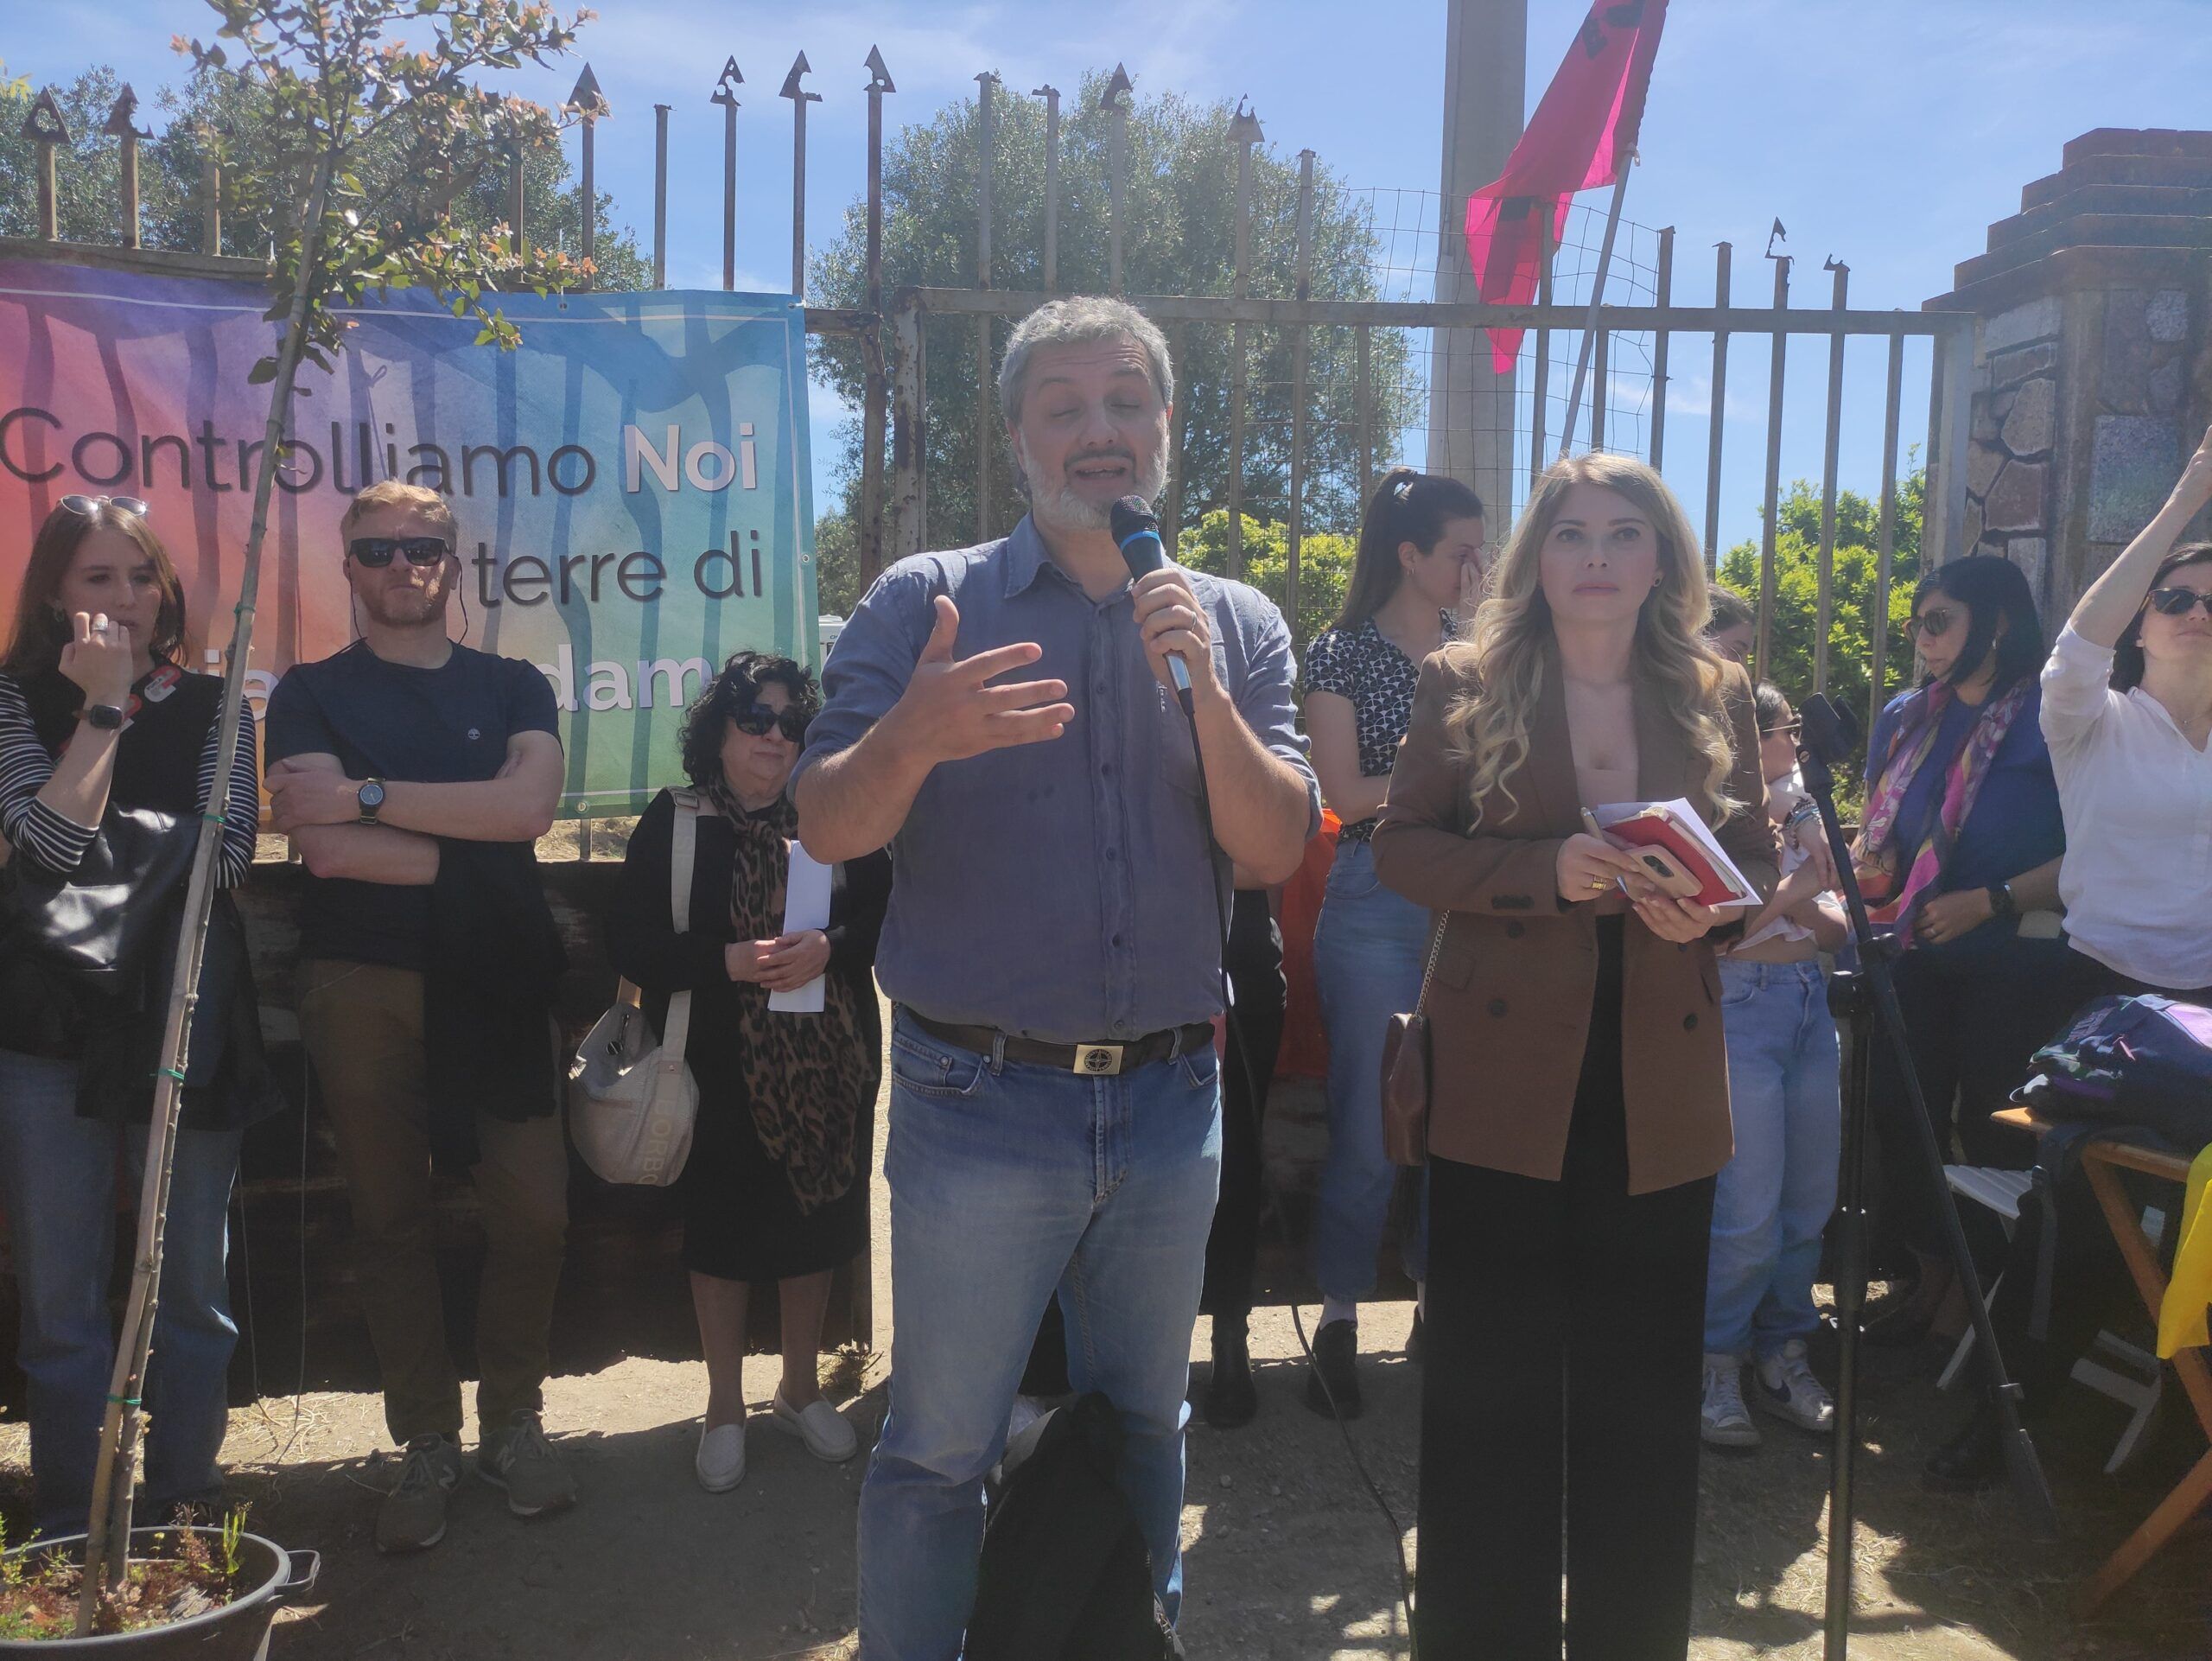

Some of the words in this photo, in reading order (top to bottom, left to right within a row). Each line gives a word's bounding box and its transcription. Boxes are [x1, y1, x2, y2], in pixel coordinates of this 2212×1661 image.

[0, 407, 596, 496] Controlliamo
[624, 422, 757, 493] Noi
[472, 542, 667, 608] terre
[694, 530, 762, 599] di
